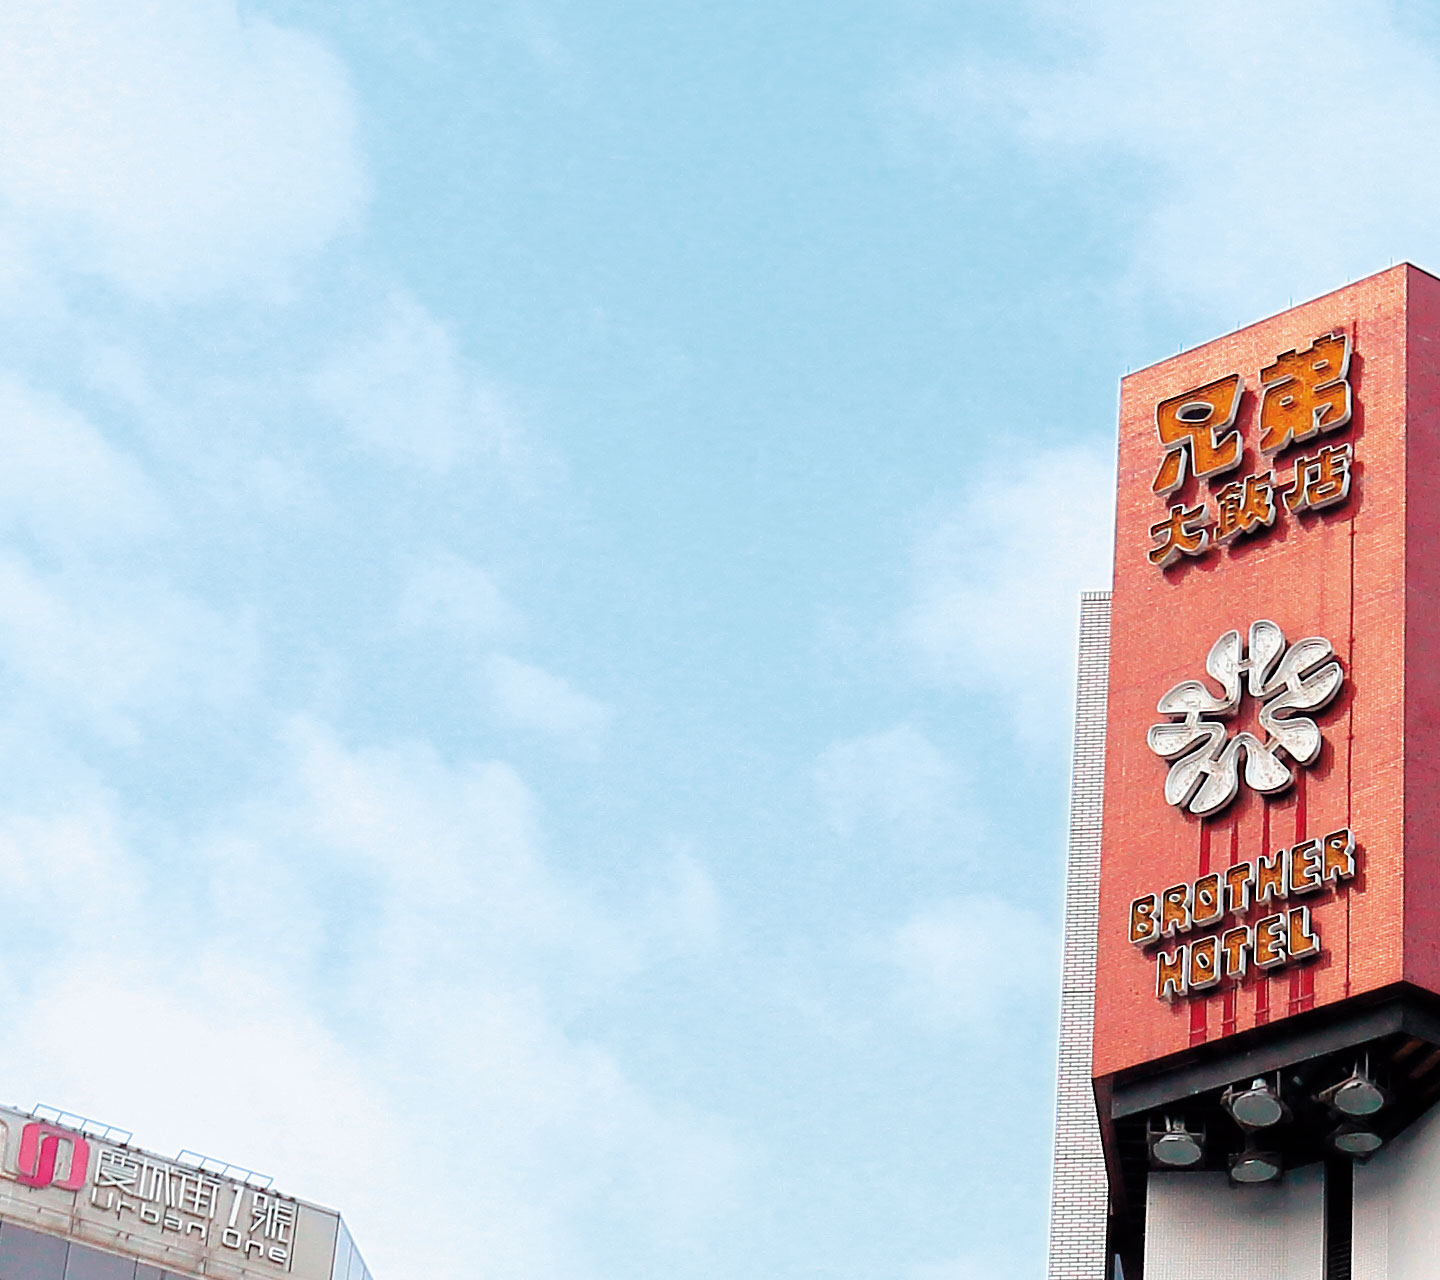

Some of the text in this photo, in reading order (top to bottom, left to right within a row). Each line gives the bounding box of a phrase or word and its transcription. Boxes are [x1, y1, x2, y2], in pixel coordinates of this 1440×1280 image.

[1153, 332, 1354, 496] 兄弟
[1148, 445, 1353, 568] 大飯店
[1129, 829, 1356, 946] BROTHER
[1156, 905, 1320, 999] HOTEL
